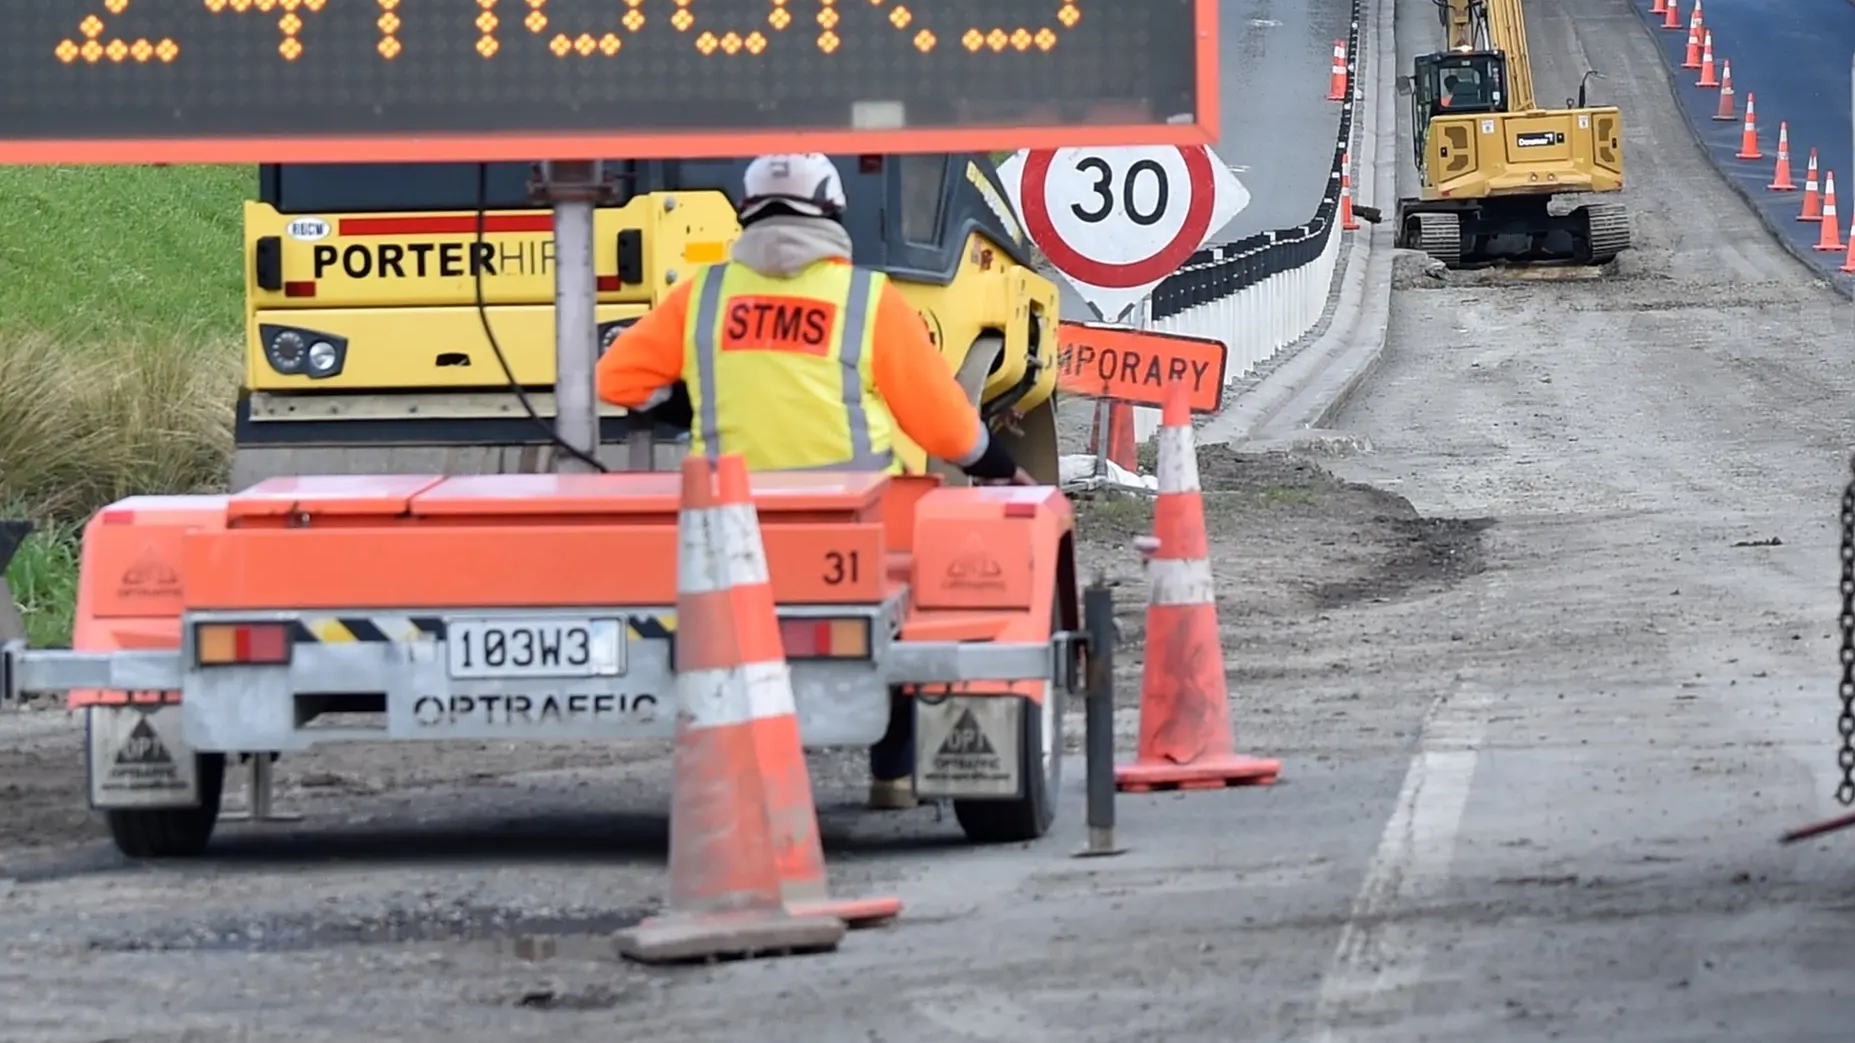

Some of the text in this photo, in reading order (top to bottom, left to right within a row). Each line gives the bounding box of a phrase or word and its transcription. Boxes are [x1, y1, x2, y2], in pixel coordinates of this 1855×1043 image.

[1070, 156, 1169, 226] 30
[728, 303, 827, 345] STMS
[1057, 343, 1209, 393] MPORARY
[823, 550, 858, 585] 31
[461, 628, 590, 668] 103W3
[413, 694, 659, 726] OPTRAFFIC
